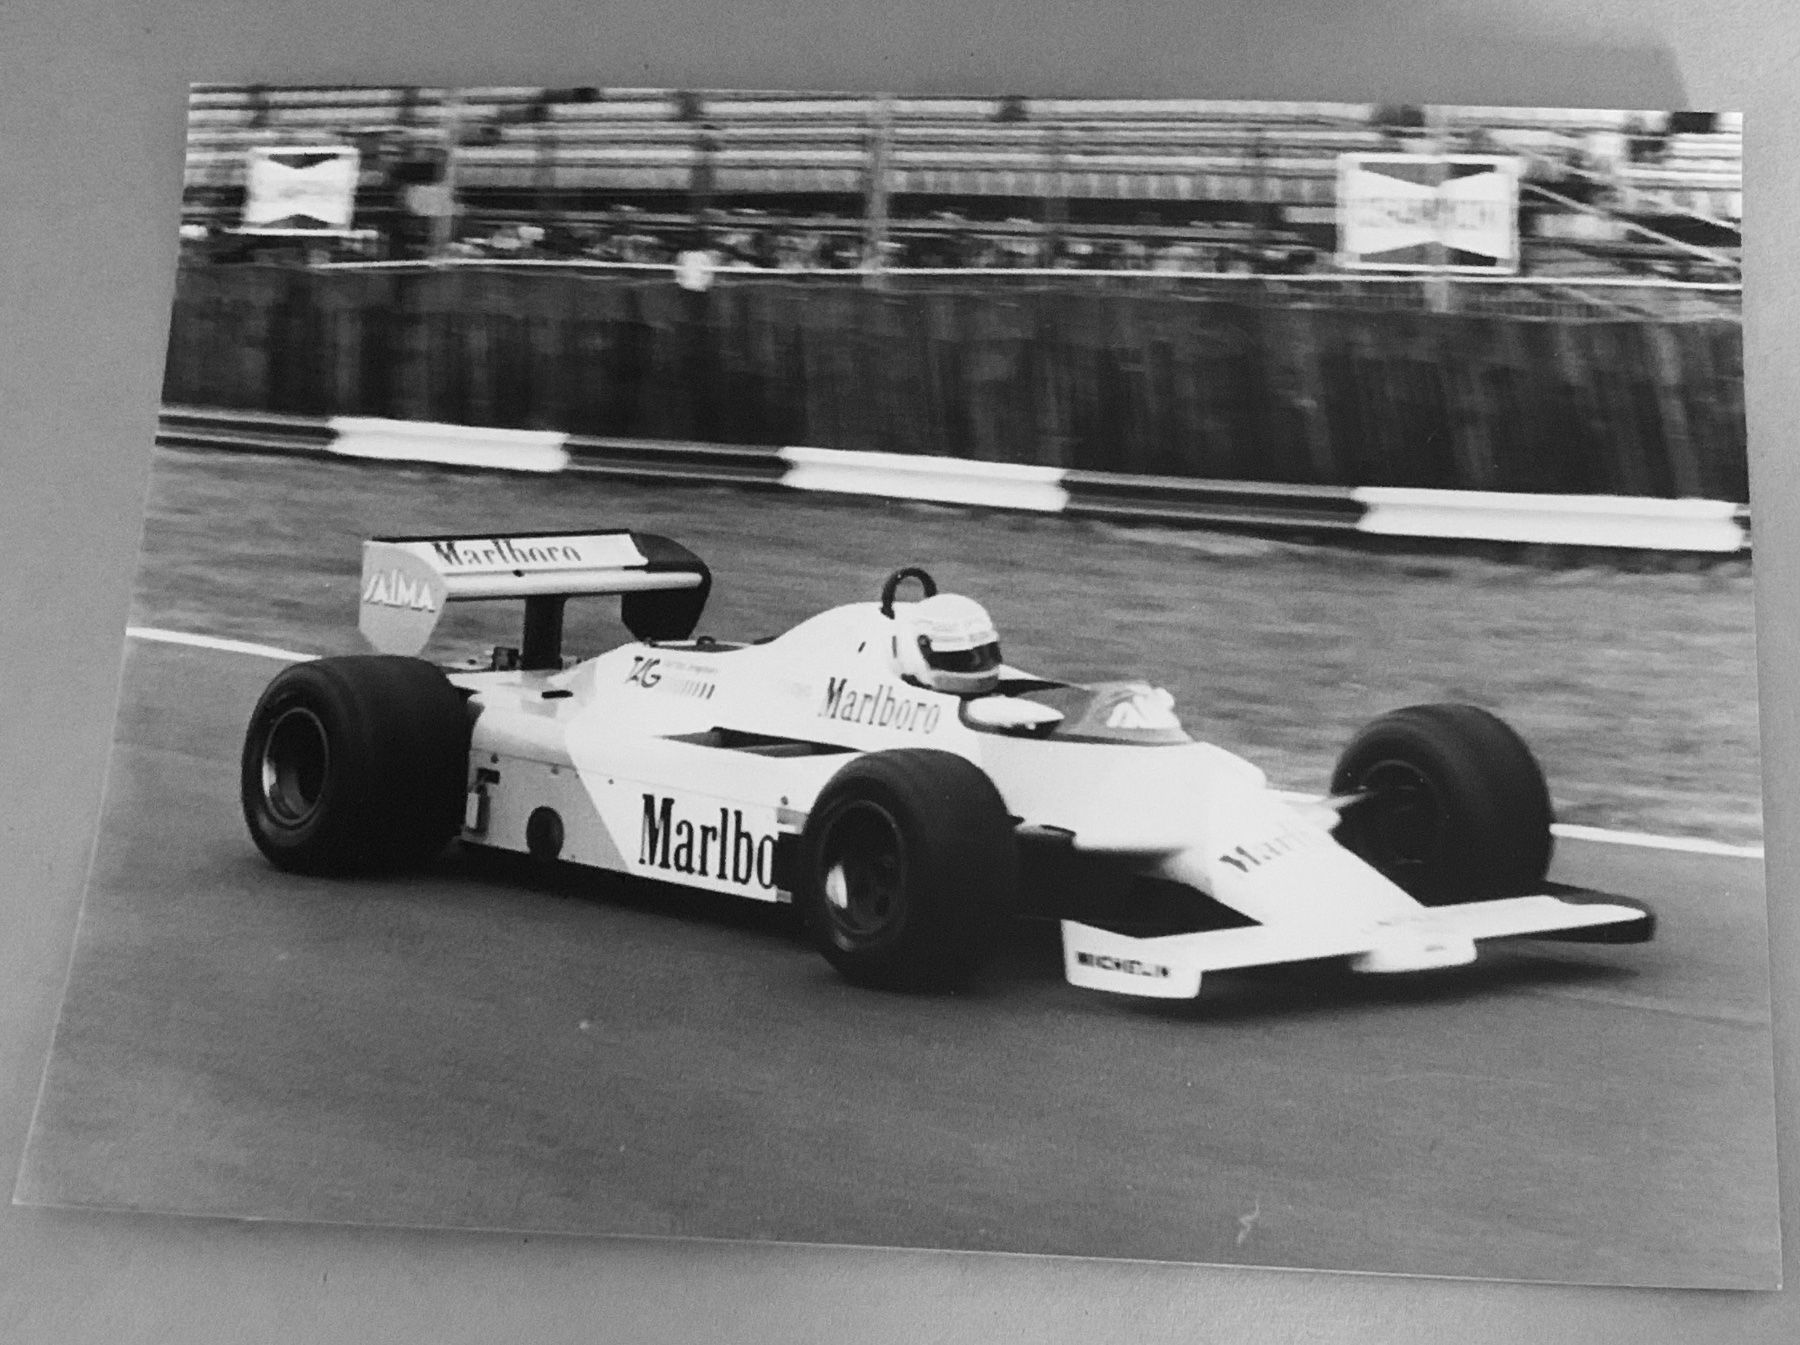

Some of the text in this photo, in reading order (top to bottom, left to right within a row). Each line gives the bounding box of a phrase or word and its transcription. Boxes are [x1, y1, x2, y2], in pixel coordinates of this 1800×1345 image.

[431, 538, 582, 565] Marlboro
[816, 677, 941, 735] Marlboro
[1076, 950, 1169, 978] MICHELIN
